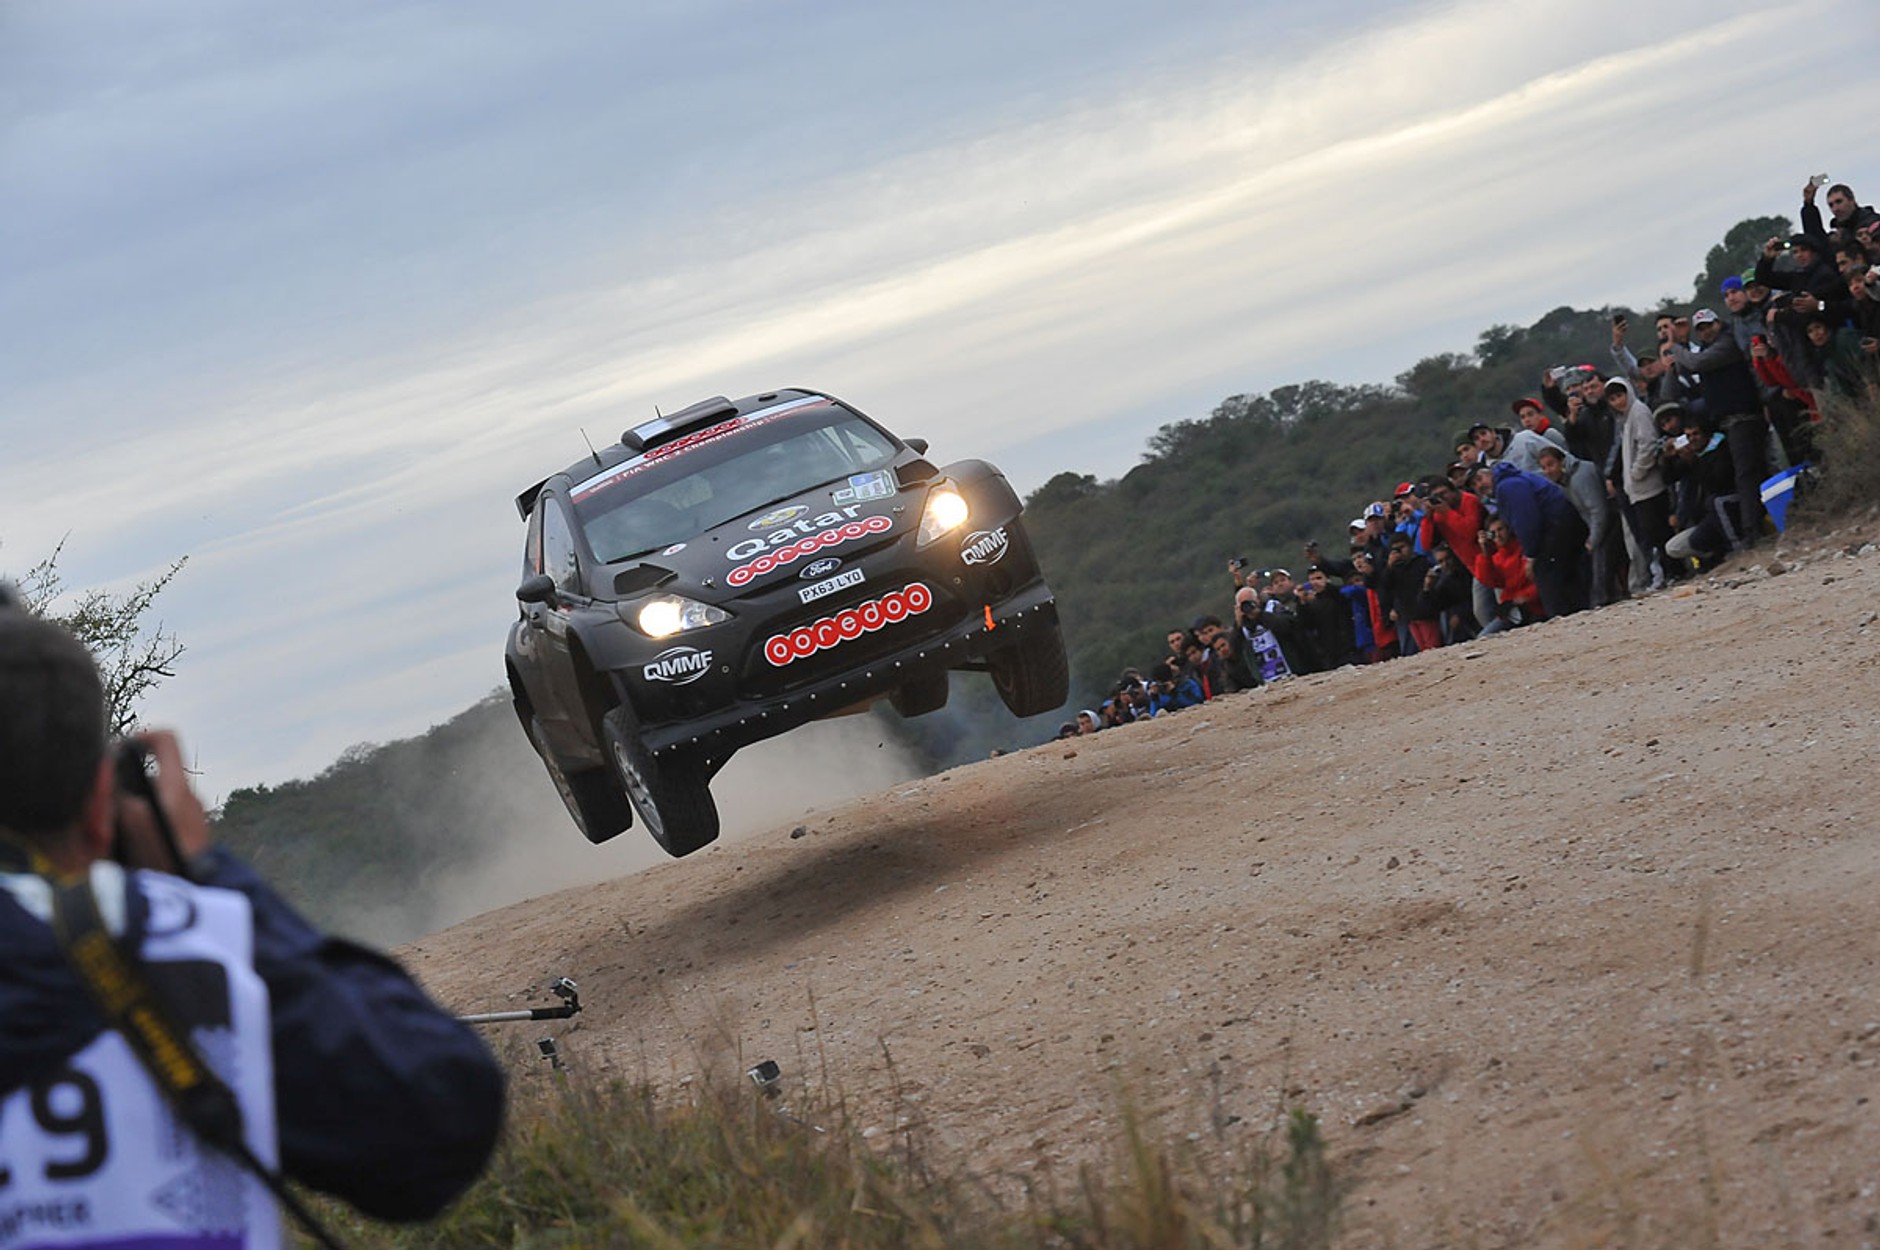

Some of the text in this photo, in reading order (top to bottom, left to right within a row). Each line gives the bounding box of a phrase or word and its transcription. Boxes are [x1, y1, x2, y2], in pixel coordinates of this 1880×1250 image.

[684, 419, 764, 451] Championship
[726, 504, 861, 560] Qatar
[961, 527, 1007, 565] QMMF
[730, 517, 889, 584] ooredoo
[809, 560, 833, 576] Ford
[802, 581, 835, 600] PX63
[768, 587, 929, 662] ooredoo
[643, 650, 713, 681] QMMF
